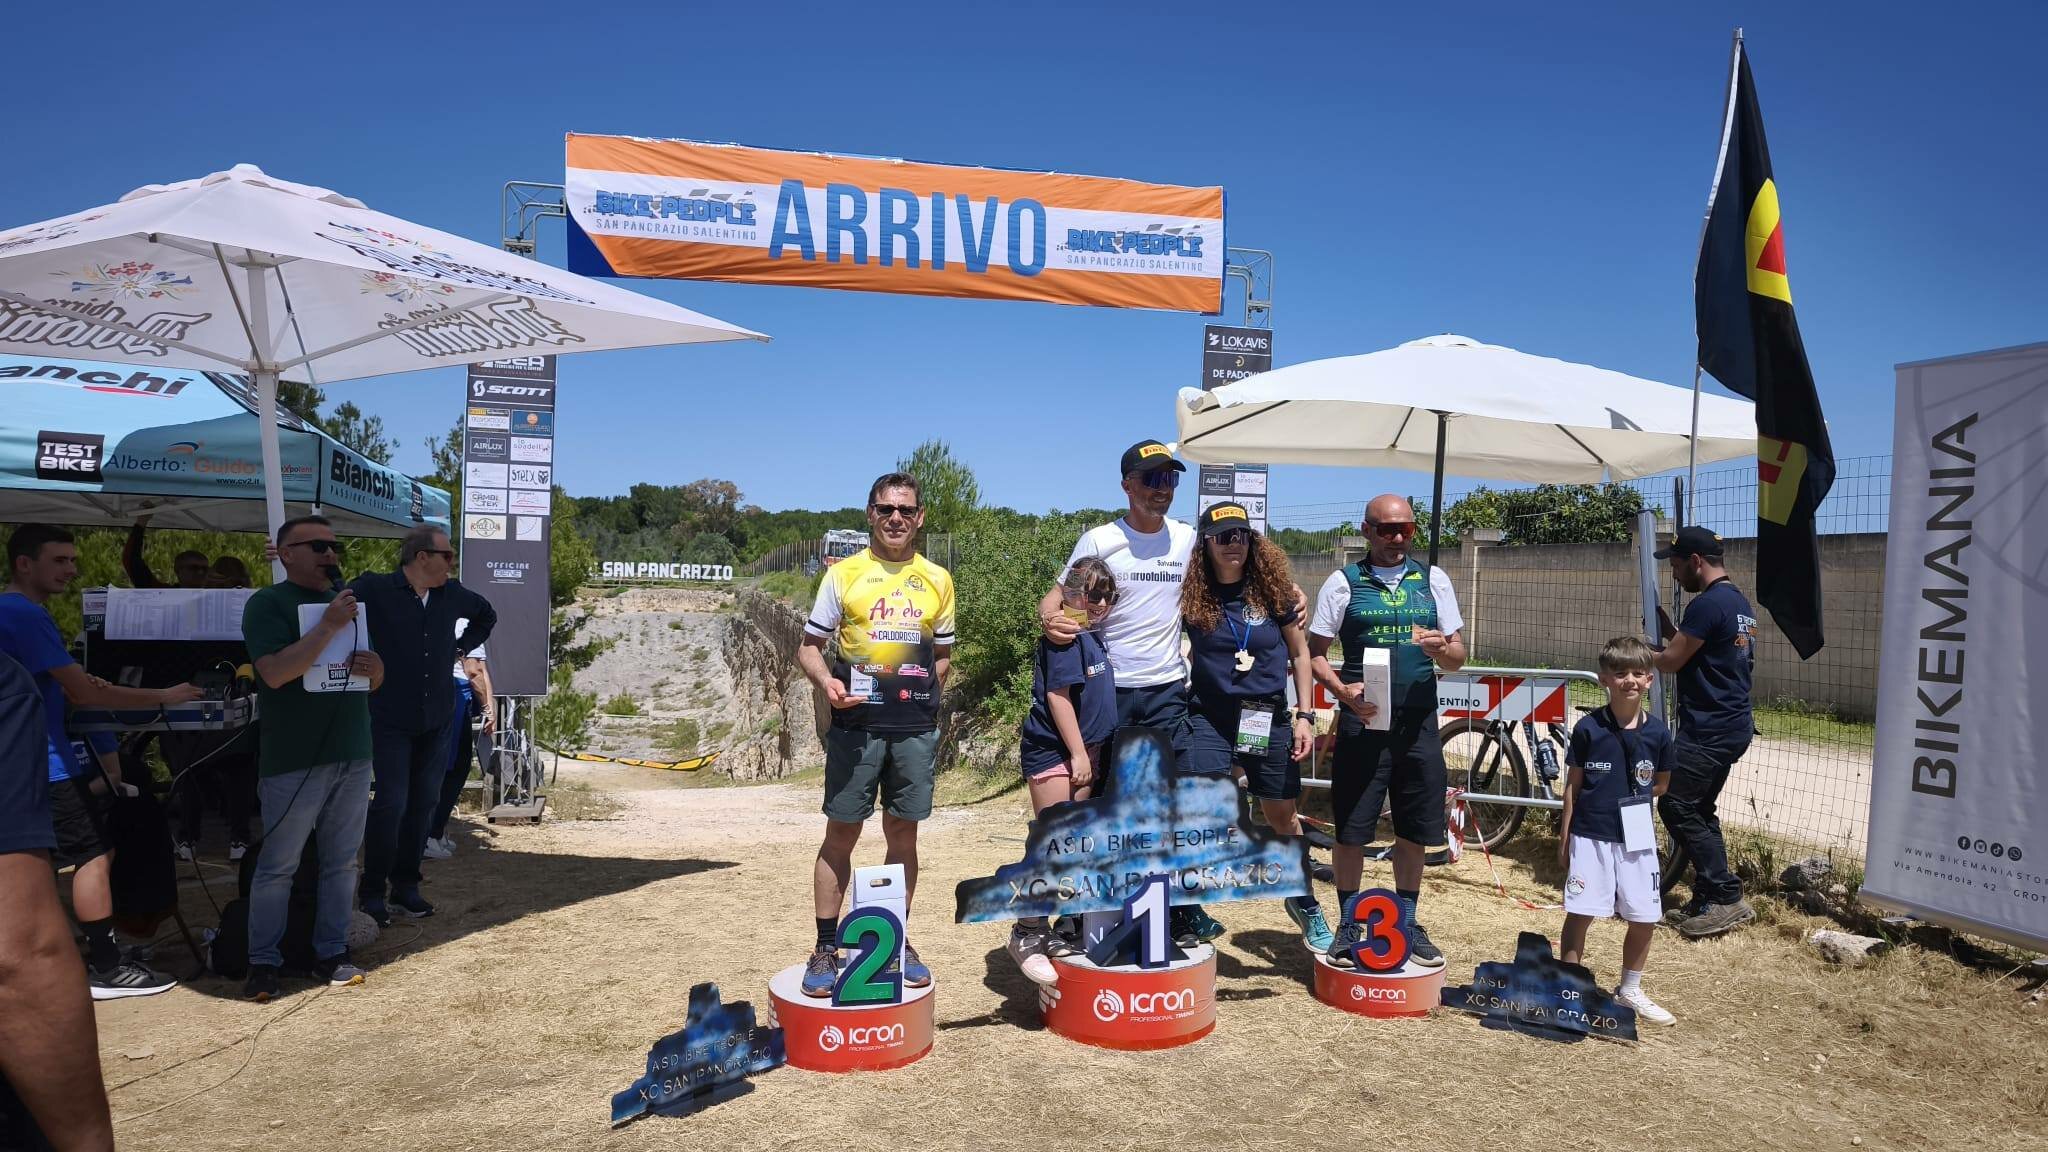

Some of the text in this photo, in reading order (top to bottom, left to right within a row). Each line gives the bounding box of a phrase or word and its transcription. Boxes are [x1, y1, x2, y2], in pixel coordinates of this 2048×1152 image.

[596, 189, 757, 226] BIKE PEOPLE
[596, 219, 757, 241] SAN PANCRAZIO SALENTINO
[768, 178, 1047, 278] ARRIVO
[1067, 228, 1204, 258] BIKE PEOPLE
[1067, 255, 1203, 271] SAN PANCRAZIO SALENTINO
[1222, 335, 1268, 349] LOKAVIS
[1212, 369, 1225, 378] DE
[487, 385, 551, 397] SCOTT
[42, 441, 98, 458] TEST
[473, 442, 503, 450] AIRLUX
[39, 456, 97, 473] BIKE
[104, 453, 186, 473] Alberto:
[330, 448, 395, 501] Bianchi
[486, 561, 530, 570] OFFICINE
[602, 561, 733, 581] SAN PANCRAZIO
[1911, 412, 1979, 799] BIKEMANIA
[878, 630, 920, 642] CALDOROSSO
[1373, 625, 1411, 634] VENU
[1243, 735, 1263, 745] STAFF
[1046, 835, 1095, 856] ASD
[1108, 832, 1153, 851] BIKE
[1008, 862, 1282, 905] XC SAN PNCRAZIO
[1894, 860, 1911, 871] Via
[1983, 882, 1997, 891] 42
[1131, 881, 1165, 963] 1
[1354, 894, 1408, 971] 3
[838, 915, 896, 1002] 2
[1466, 992, 1486, 1007] XC
[1490, 997, 1521, 1012] SAN
[652, 1054, 679, 1072] ASD
[640, 1083, 659, 1102] XC
[663, 1073, 692, 1095] SAN
